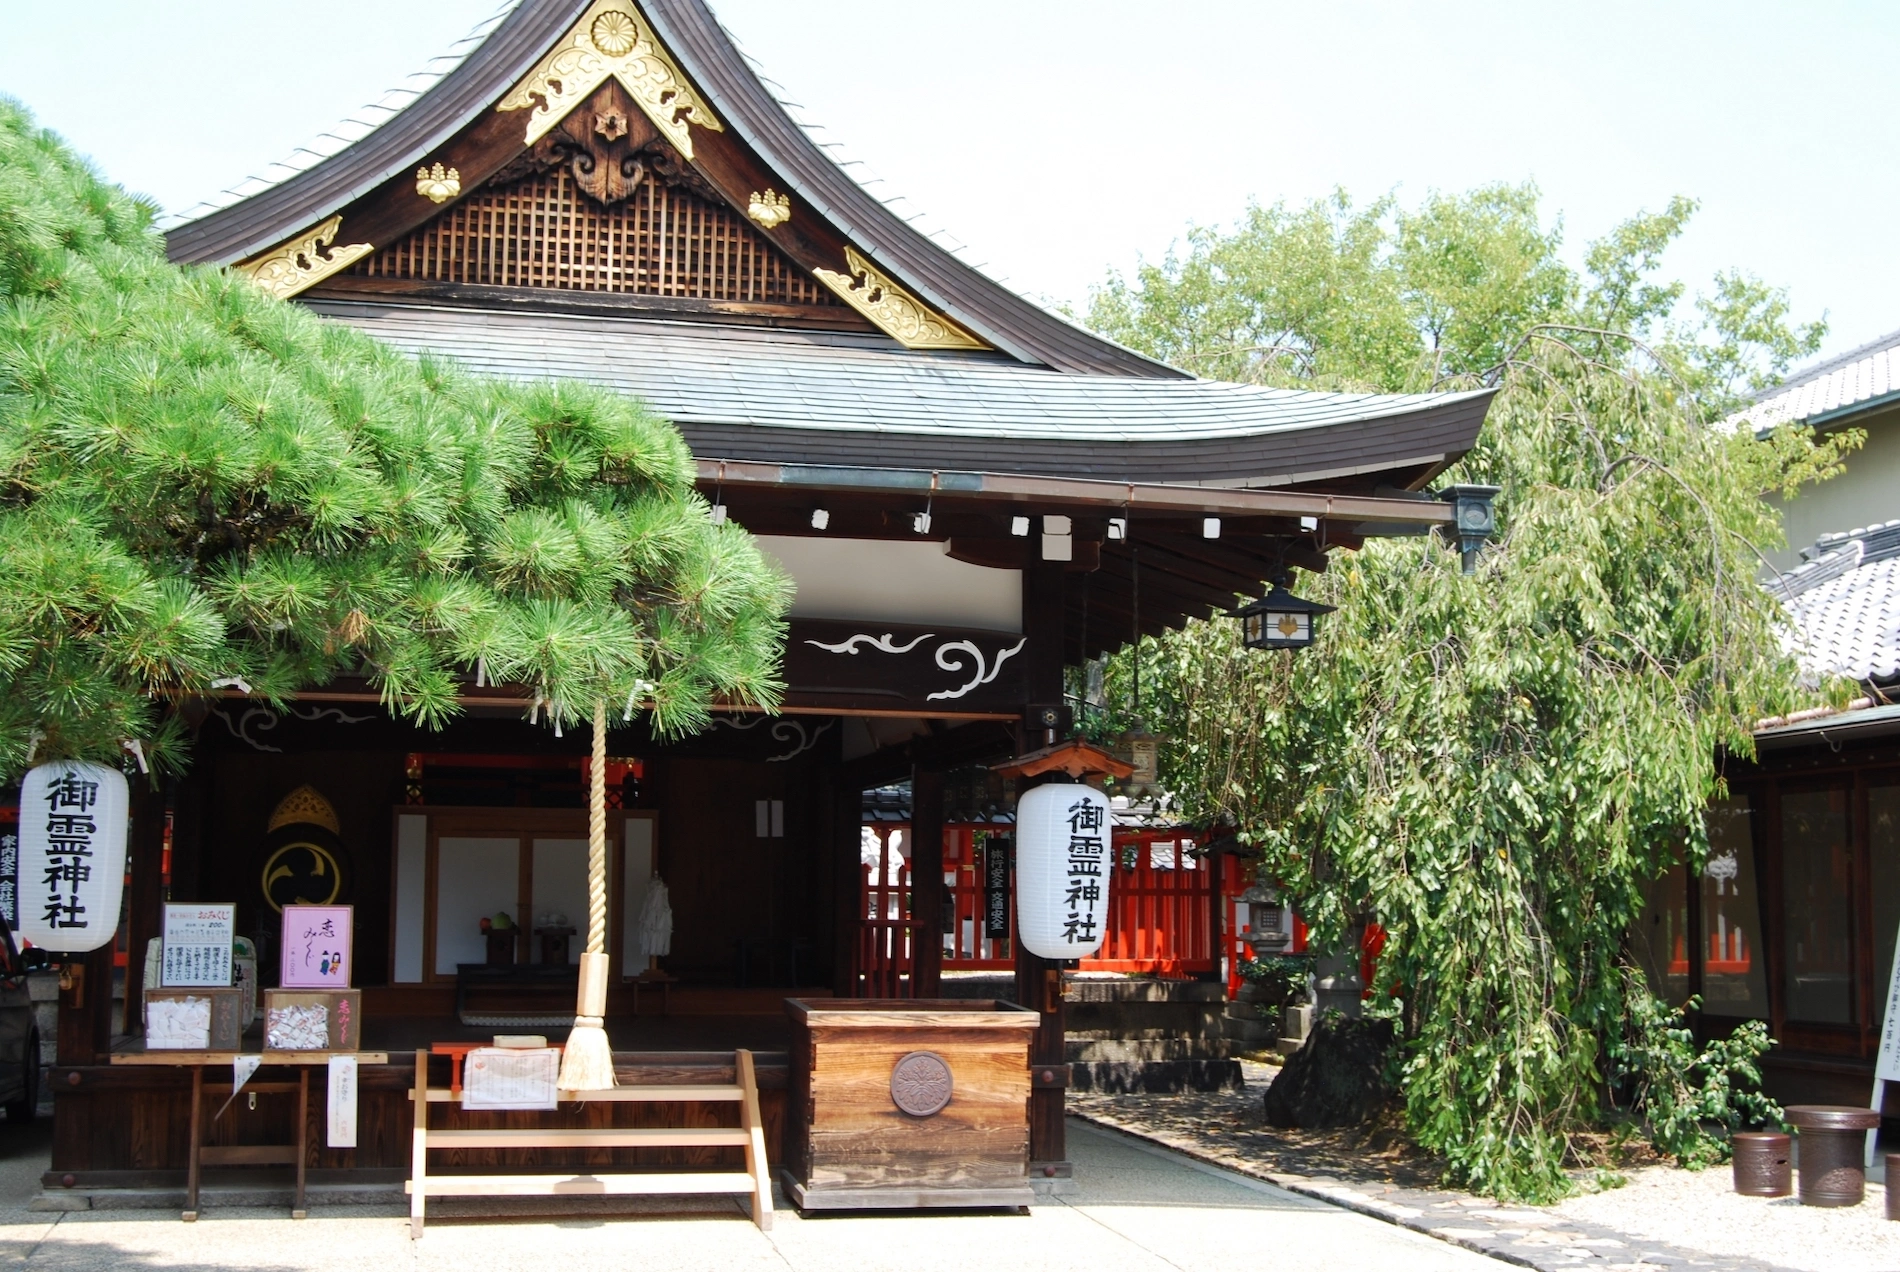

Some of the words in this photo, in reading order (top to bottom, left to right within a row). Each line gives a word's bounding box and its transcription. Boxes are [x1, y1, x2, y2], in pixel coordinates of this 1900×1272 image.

[41, 772, 99, 929] 御霊神社
[991, 849, 1004, 888] 旅行安全
[1060, 797, 1104, 944] 御霊神社
[198, 911, 230, 921] おみくじ
